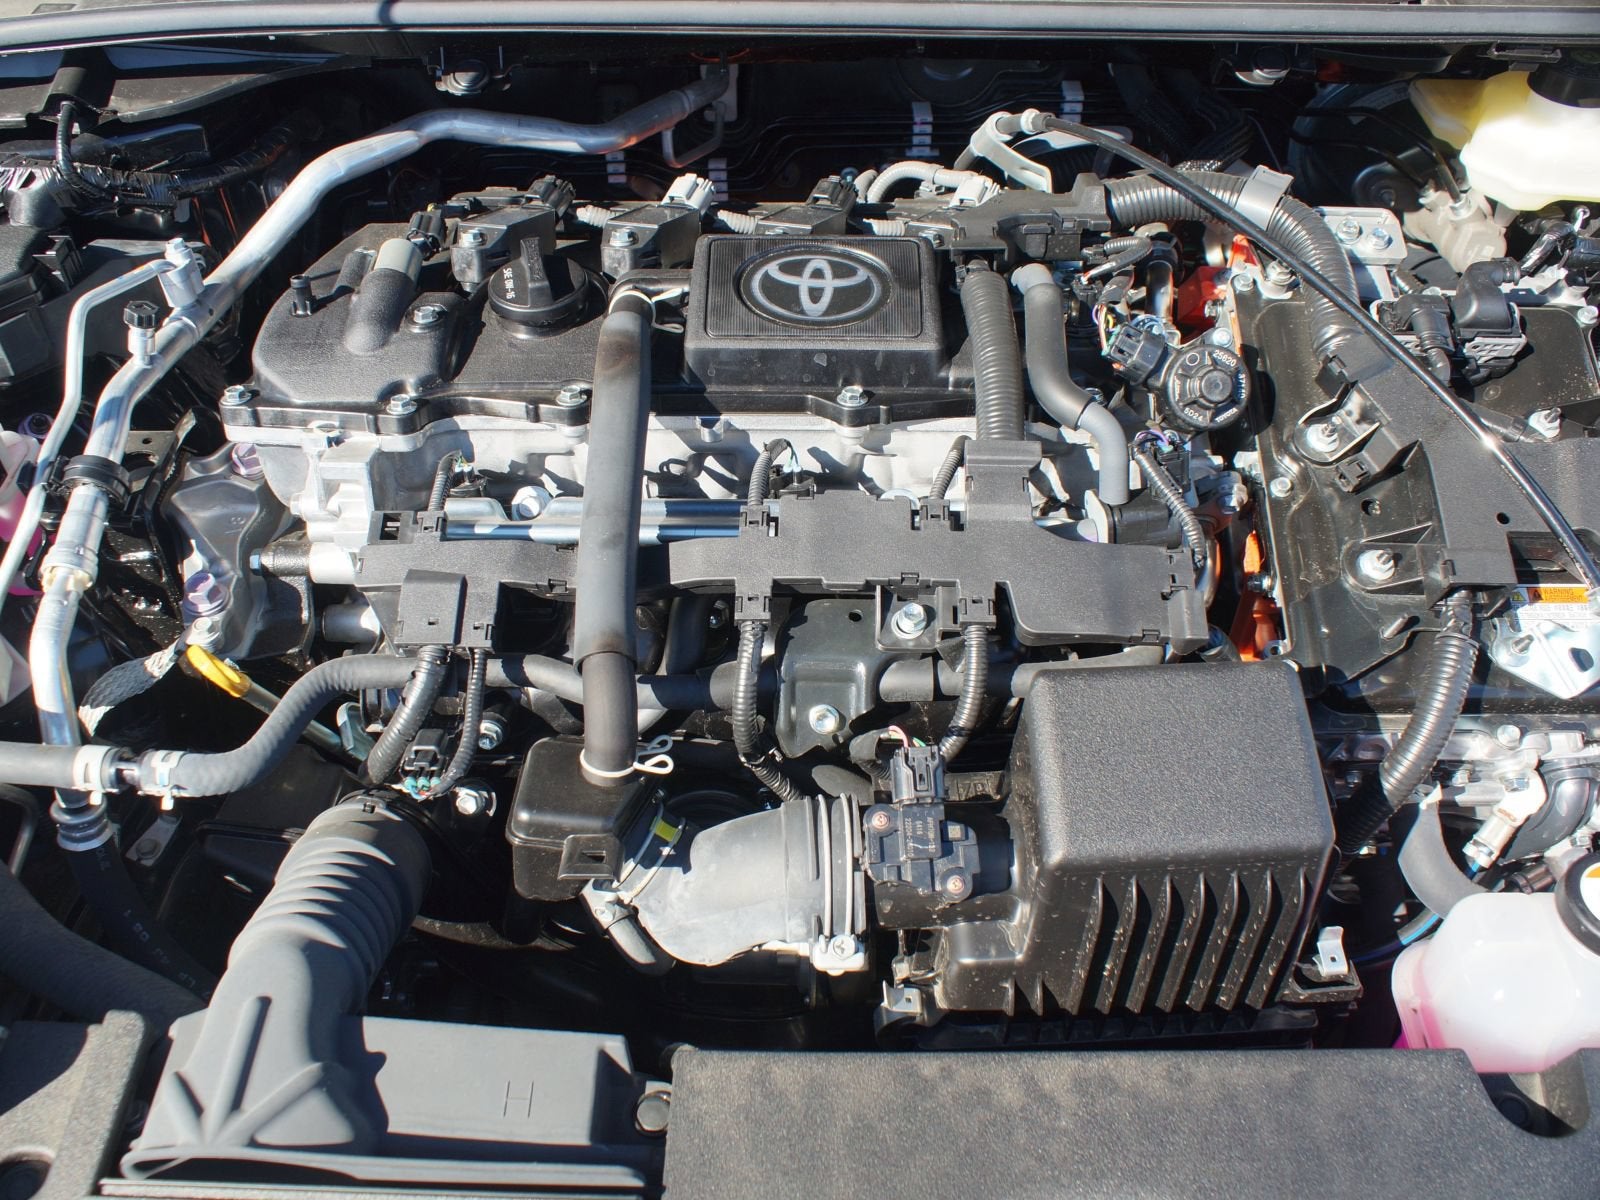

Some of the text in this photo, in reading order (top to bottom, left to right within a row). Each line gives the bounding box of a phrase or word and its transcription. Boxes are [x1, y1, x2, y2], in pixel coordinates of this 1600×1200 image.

[503, 267, 515, 298] SAE 0W-16
[1215, 407, 1238, 423] TOYOTA
